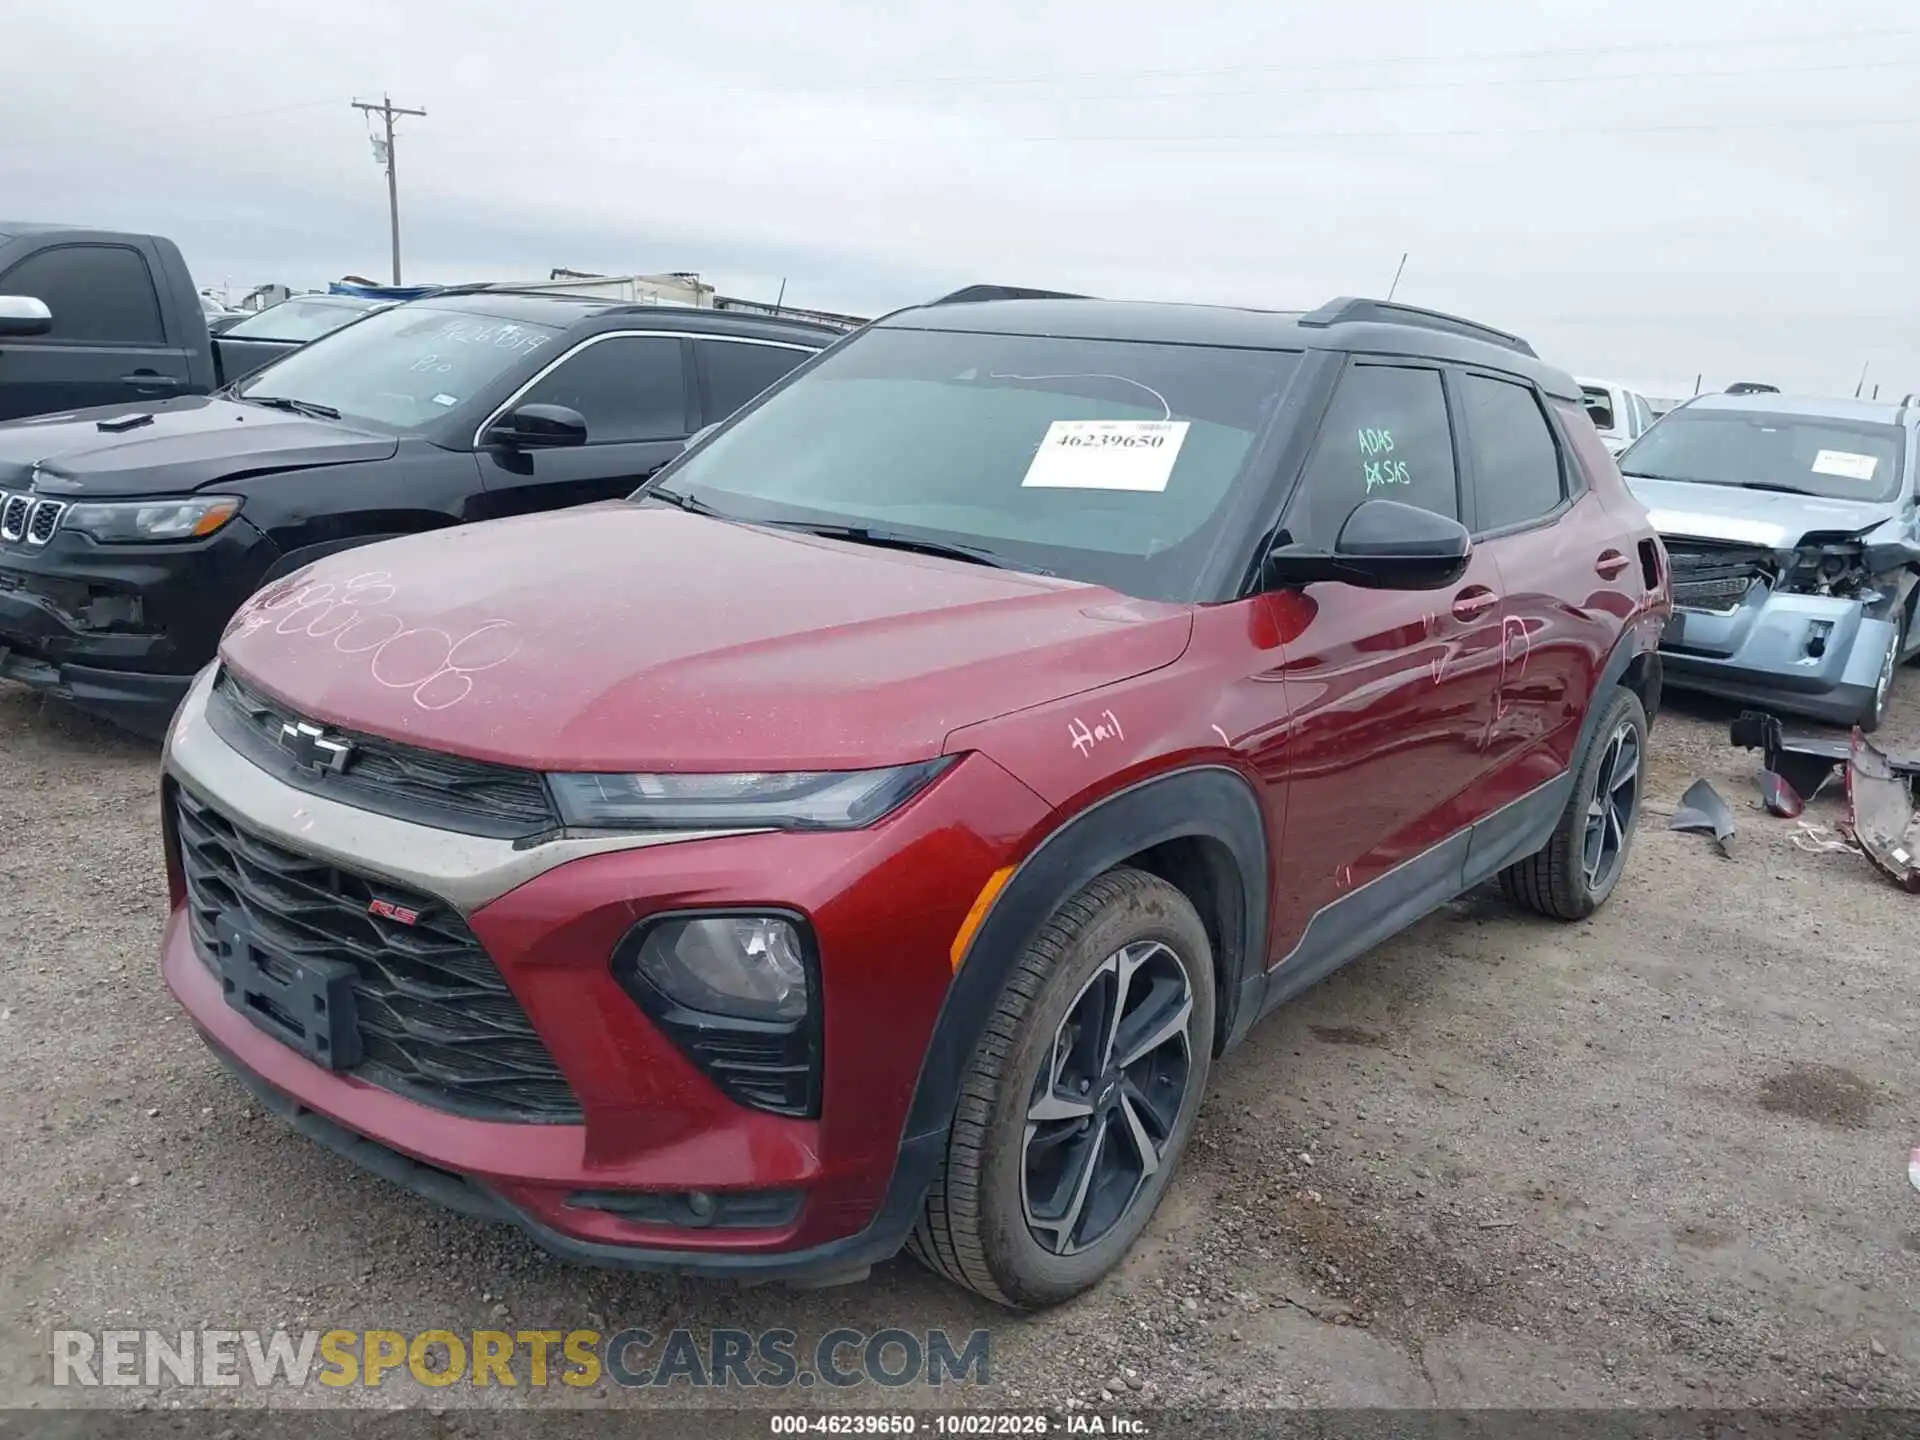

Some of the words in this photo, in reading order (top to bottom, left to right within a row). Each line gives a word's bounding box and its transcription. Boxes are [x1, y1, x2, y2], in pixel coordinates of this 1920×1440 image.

[1056, 433, 1165, 449] 46239650
[1067, 709, 1125, 758] Hail
[367, 899, 420, 926] RS
